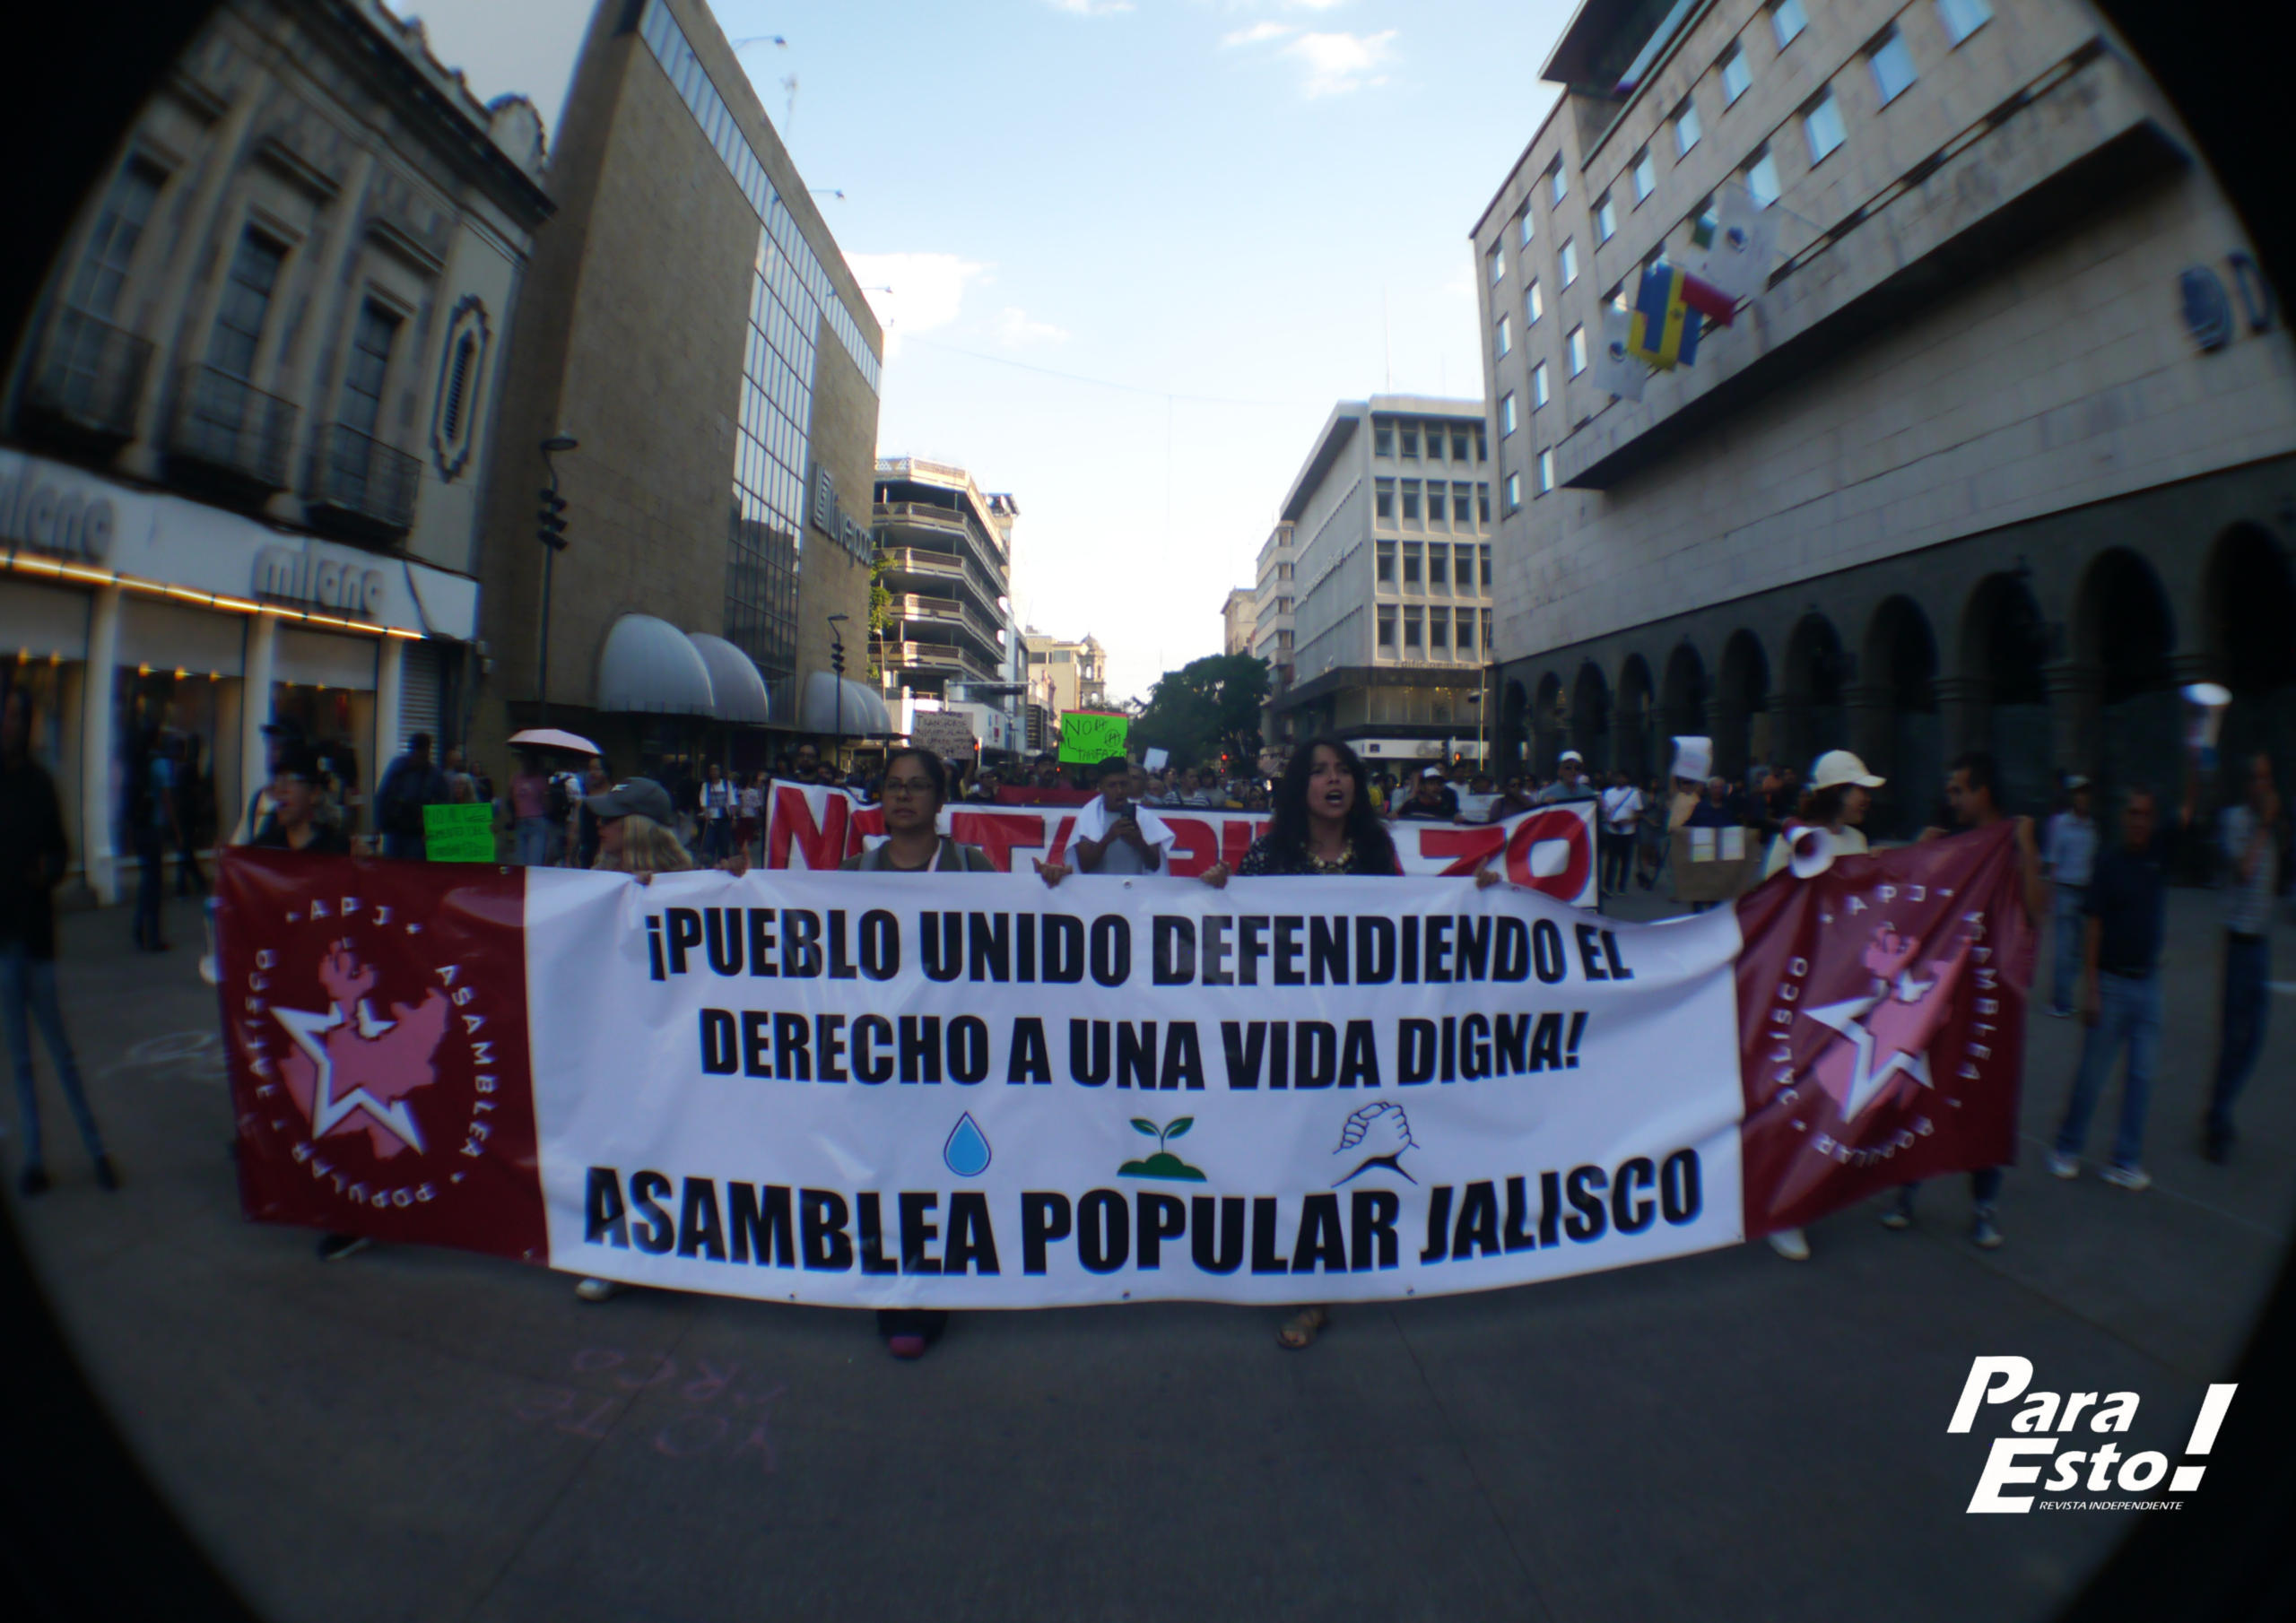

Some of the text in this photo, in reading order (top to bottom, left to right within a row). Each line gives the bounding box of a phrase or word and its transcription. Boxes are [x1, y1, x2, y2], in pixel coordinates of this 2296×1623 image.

[1060, 737, 1077, 750] AL
[1065, 718, 1092, 736] NO
[425, 809, 444, 825] NO
[645, 907, 1635, 988] ¡PUEBLO UNIDO DEFENDIENDO EL
[435, 964, 498, 1159] ASAMBLEA
[699, 1008, 1590, 1091] DERECHO A UNA VIDA DIGNA!
[1768, 956, 1809, 1106] JALISCO
[291, 1141, 438, 1209] POPULAR
[584, 1147, 1703, 1277] ASAMBLEA POPULAR JALISCO
